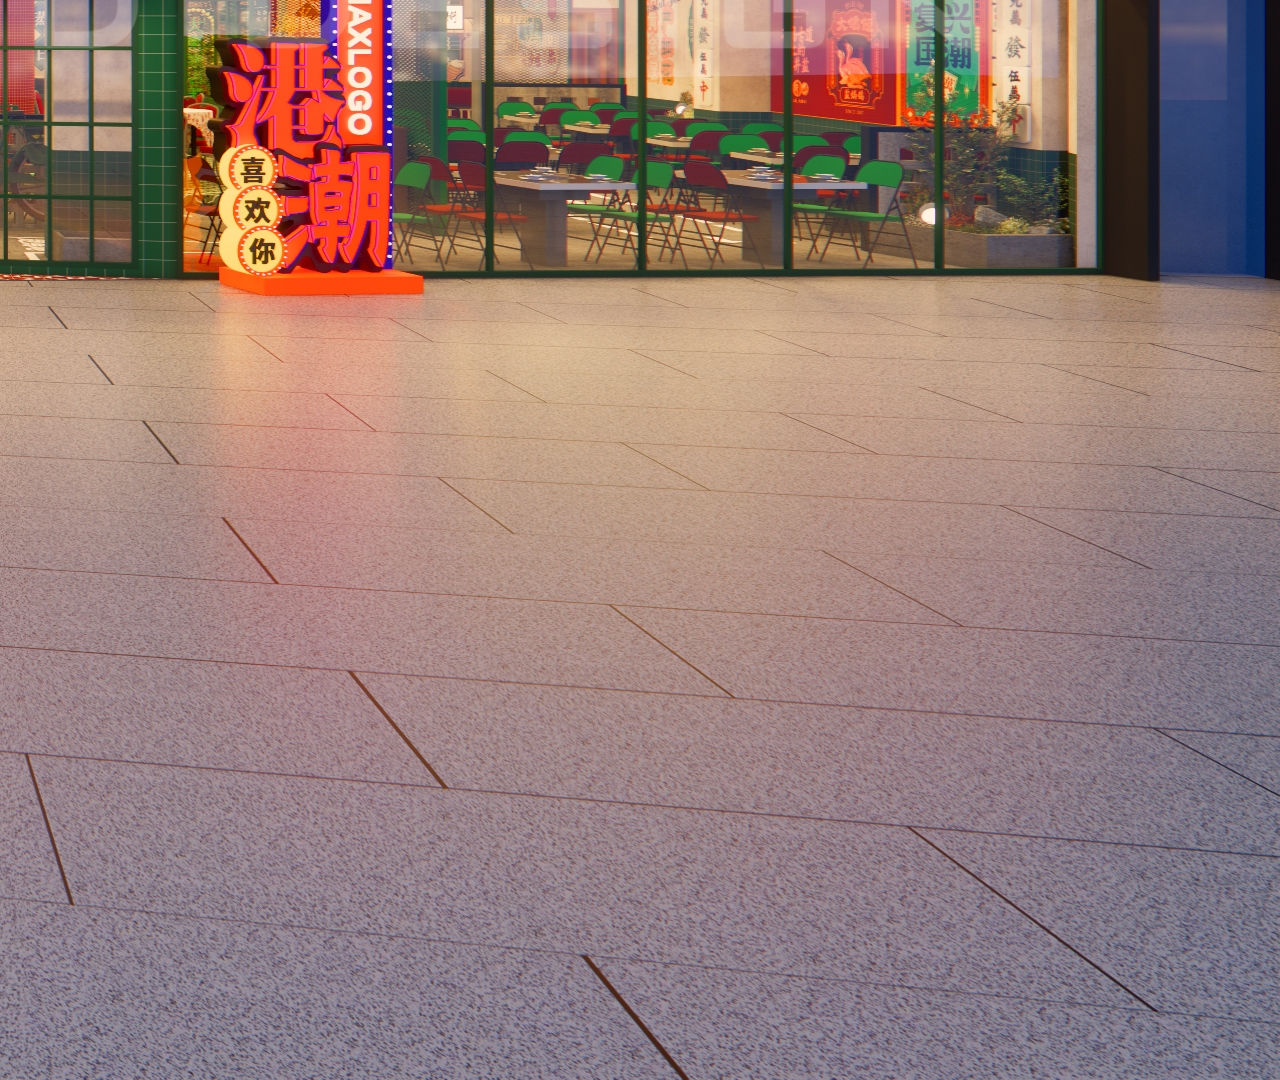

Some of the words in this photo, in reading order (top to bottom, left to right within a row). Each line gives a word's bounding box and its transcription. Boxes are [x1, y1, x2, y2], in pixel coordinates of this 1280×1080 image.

[221, 41, 392, 270] 港潮
[240, 157, 276, 265] 喜欢你
